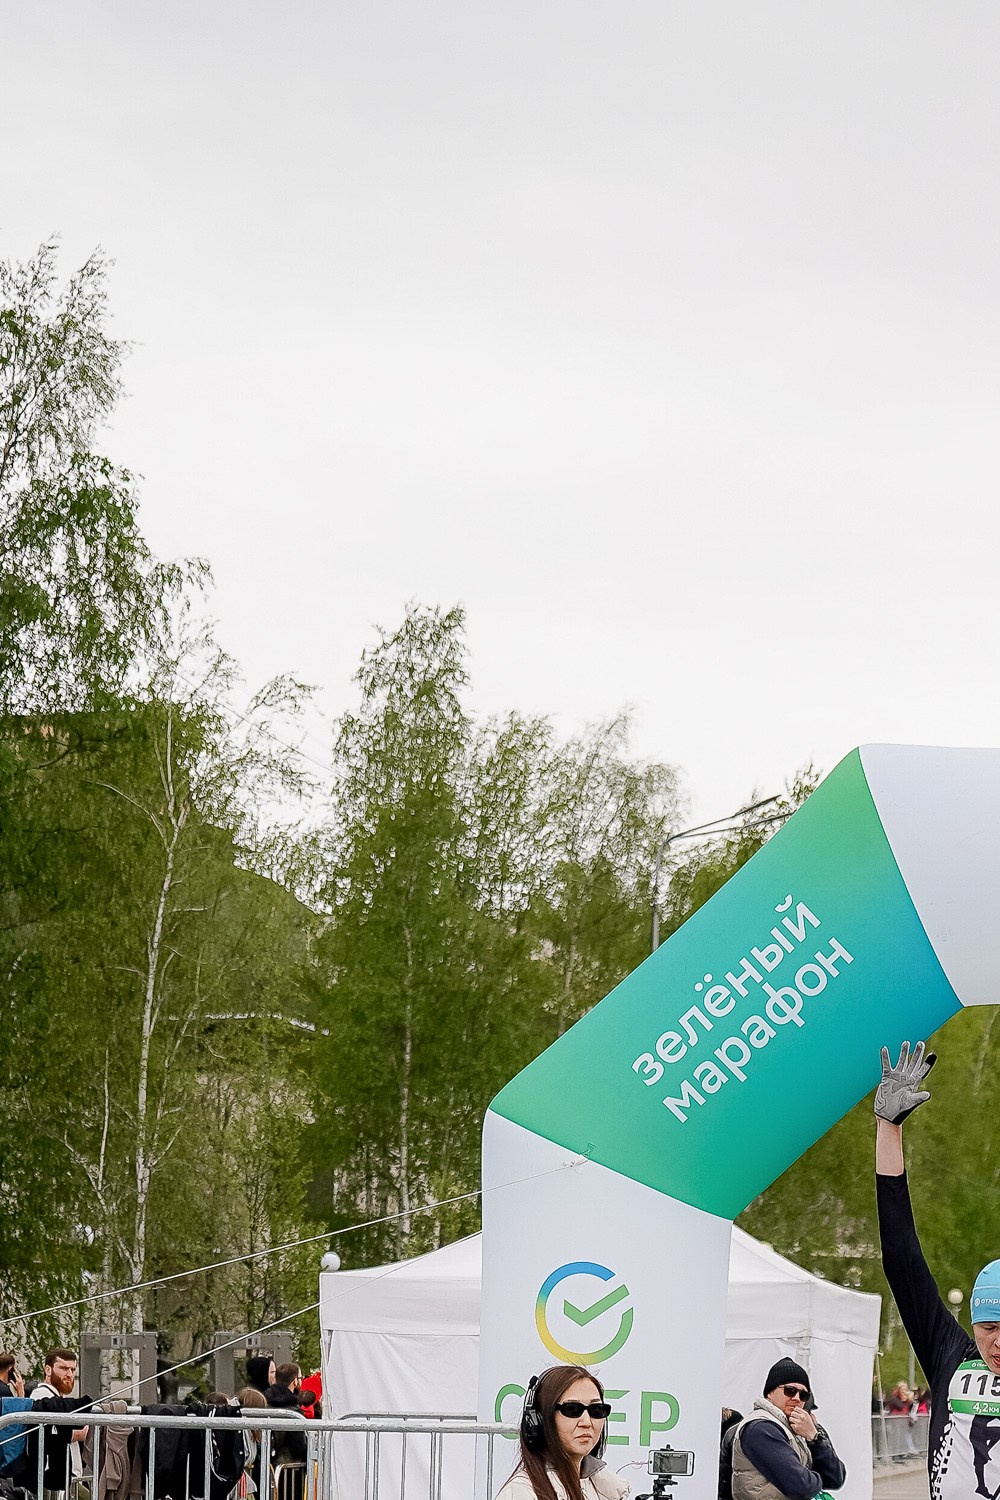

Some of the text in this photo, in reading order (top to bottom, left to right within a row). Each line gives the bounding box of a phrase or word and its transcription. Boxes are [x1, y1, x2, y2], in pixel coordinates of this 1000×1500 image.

[631, 893, 822, 1087] зелёный
[662, 936, 855, 1124] марафон
[494, 1383, 680, 1447] СЕР
